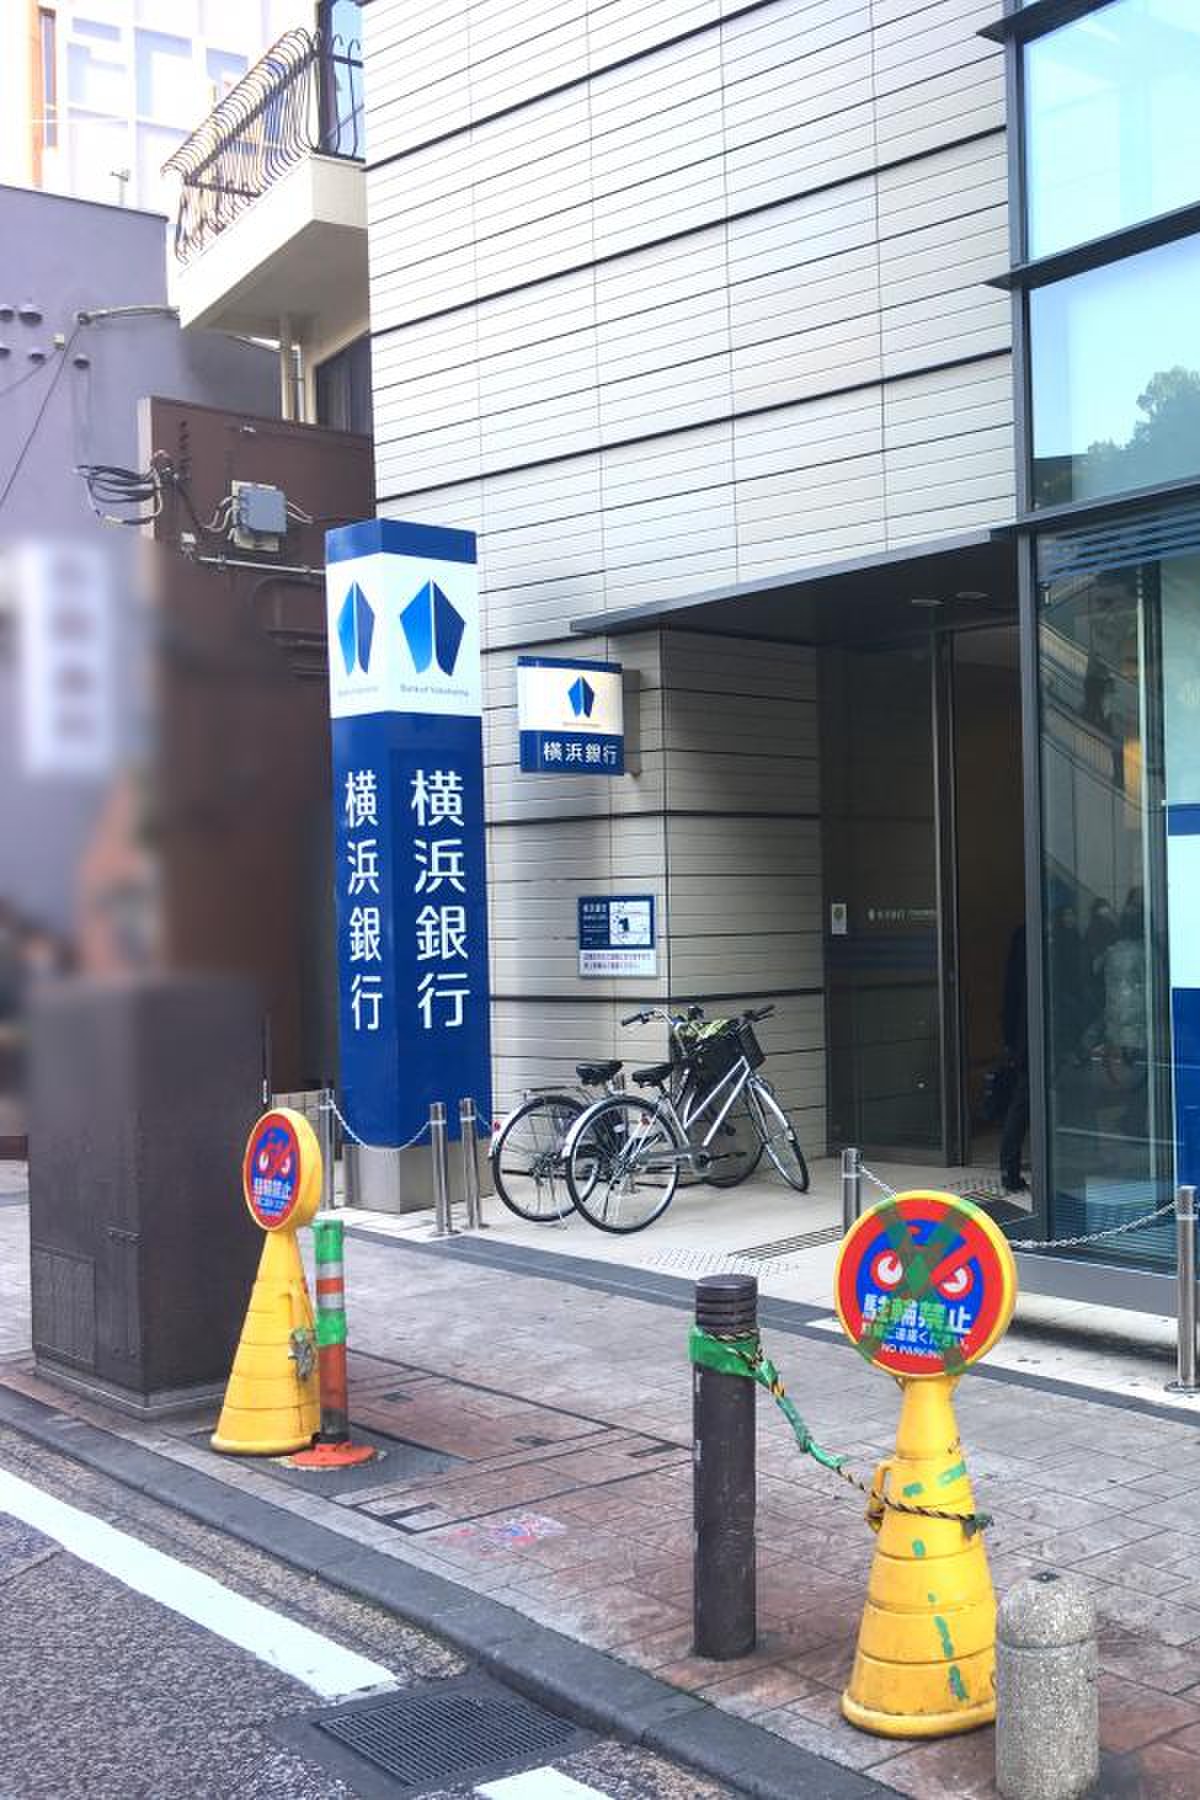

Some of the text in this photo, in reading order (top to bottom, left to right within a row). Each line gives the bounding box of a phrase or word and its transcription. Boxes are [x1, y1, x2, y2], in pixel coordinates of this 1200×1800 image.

[544, 741, 618, 765] 横浜銀行
[345, 769, 383, 1032] 横浜銀行
[410, 769, 471, 1030] 横浜銀行
